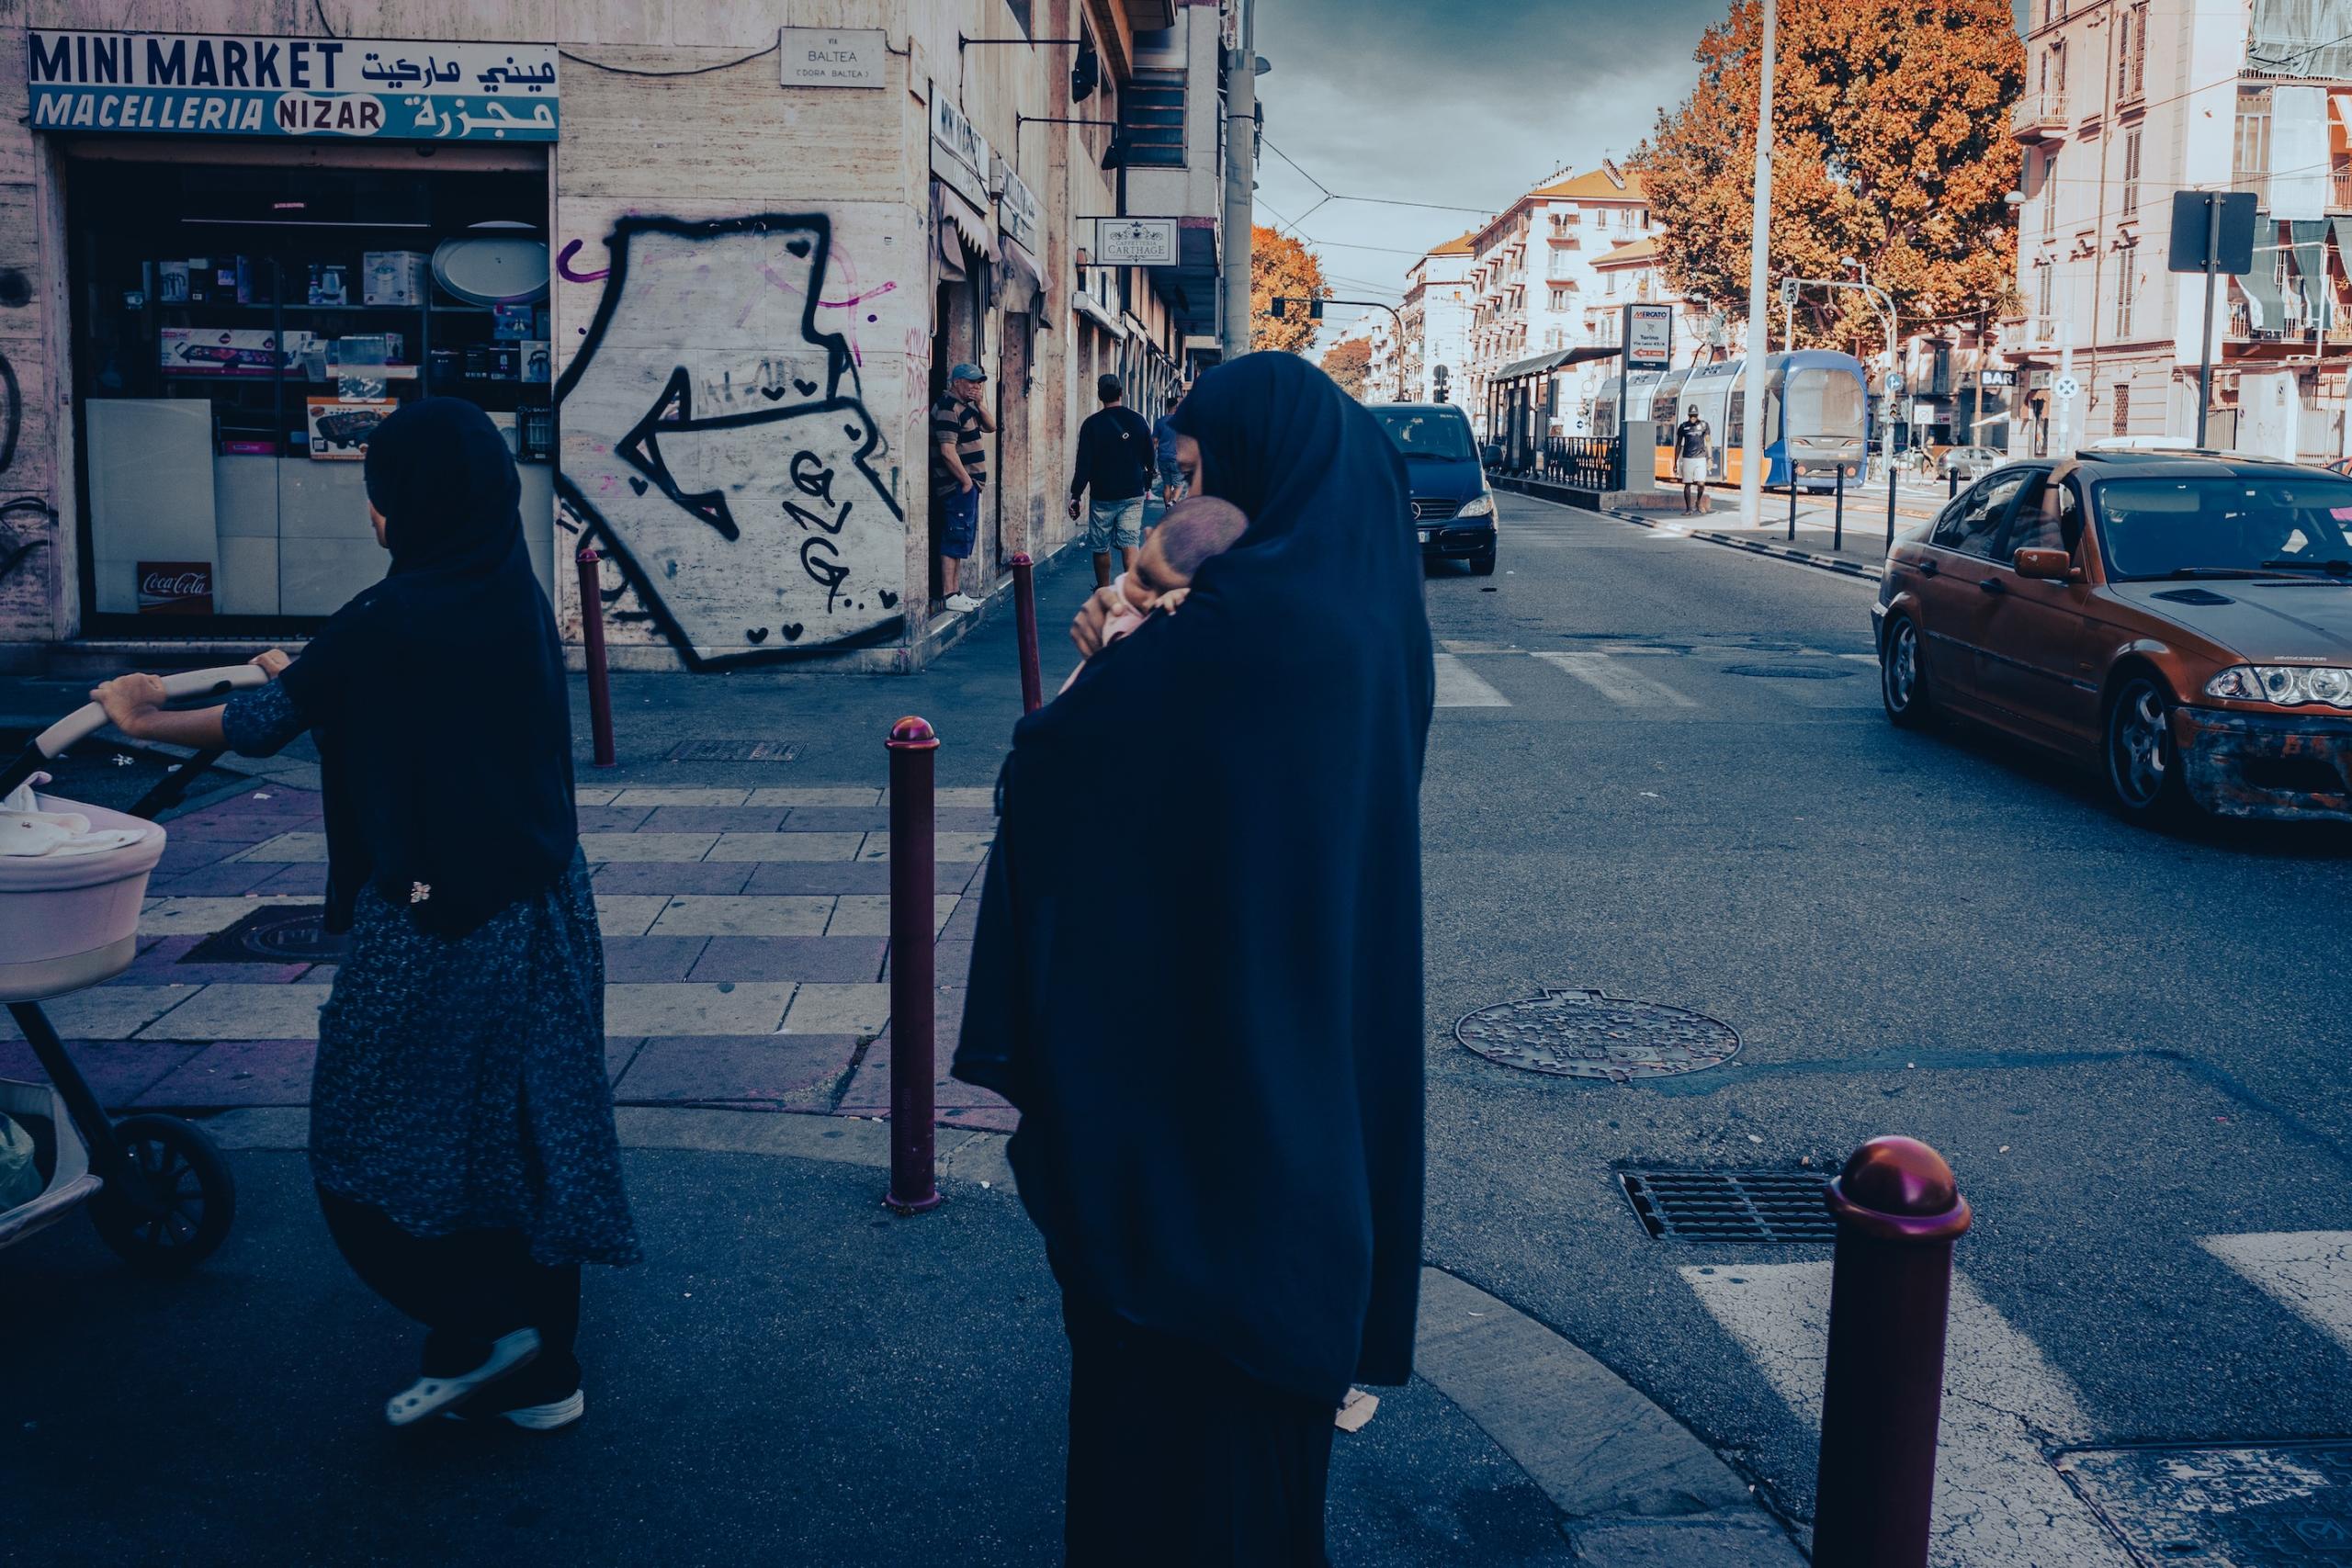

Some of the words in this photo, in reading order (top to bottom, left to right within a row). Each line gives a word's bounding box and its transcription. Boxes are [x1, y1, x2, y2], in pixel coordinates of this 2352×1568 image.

[28, 34, 134, 85] MINI
[147, 38, 344, 89] MARKET
[361, 51, 460, 89] ماركيت
[476, 55, 556, 93] ميني
[808, 51, 857, 62] BALTEA
[34, 93, 264, 131] MACELLERIA
[279, 99, 381, 130] NIZAR
[403, 95, 556, 138] مجزرة
[1108, 244, 1165, 254] CARTHAGE
[1982, 371, 2013, 384] BAR
